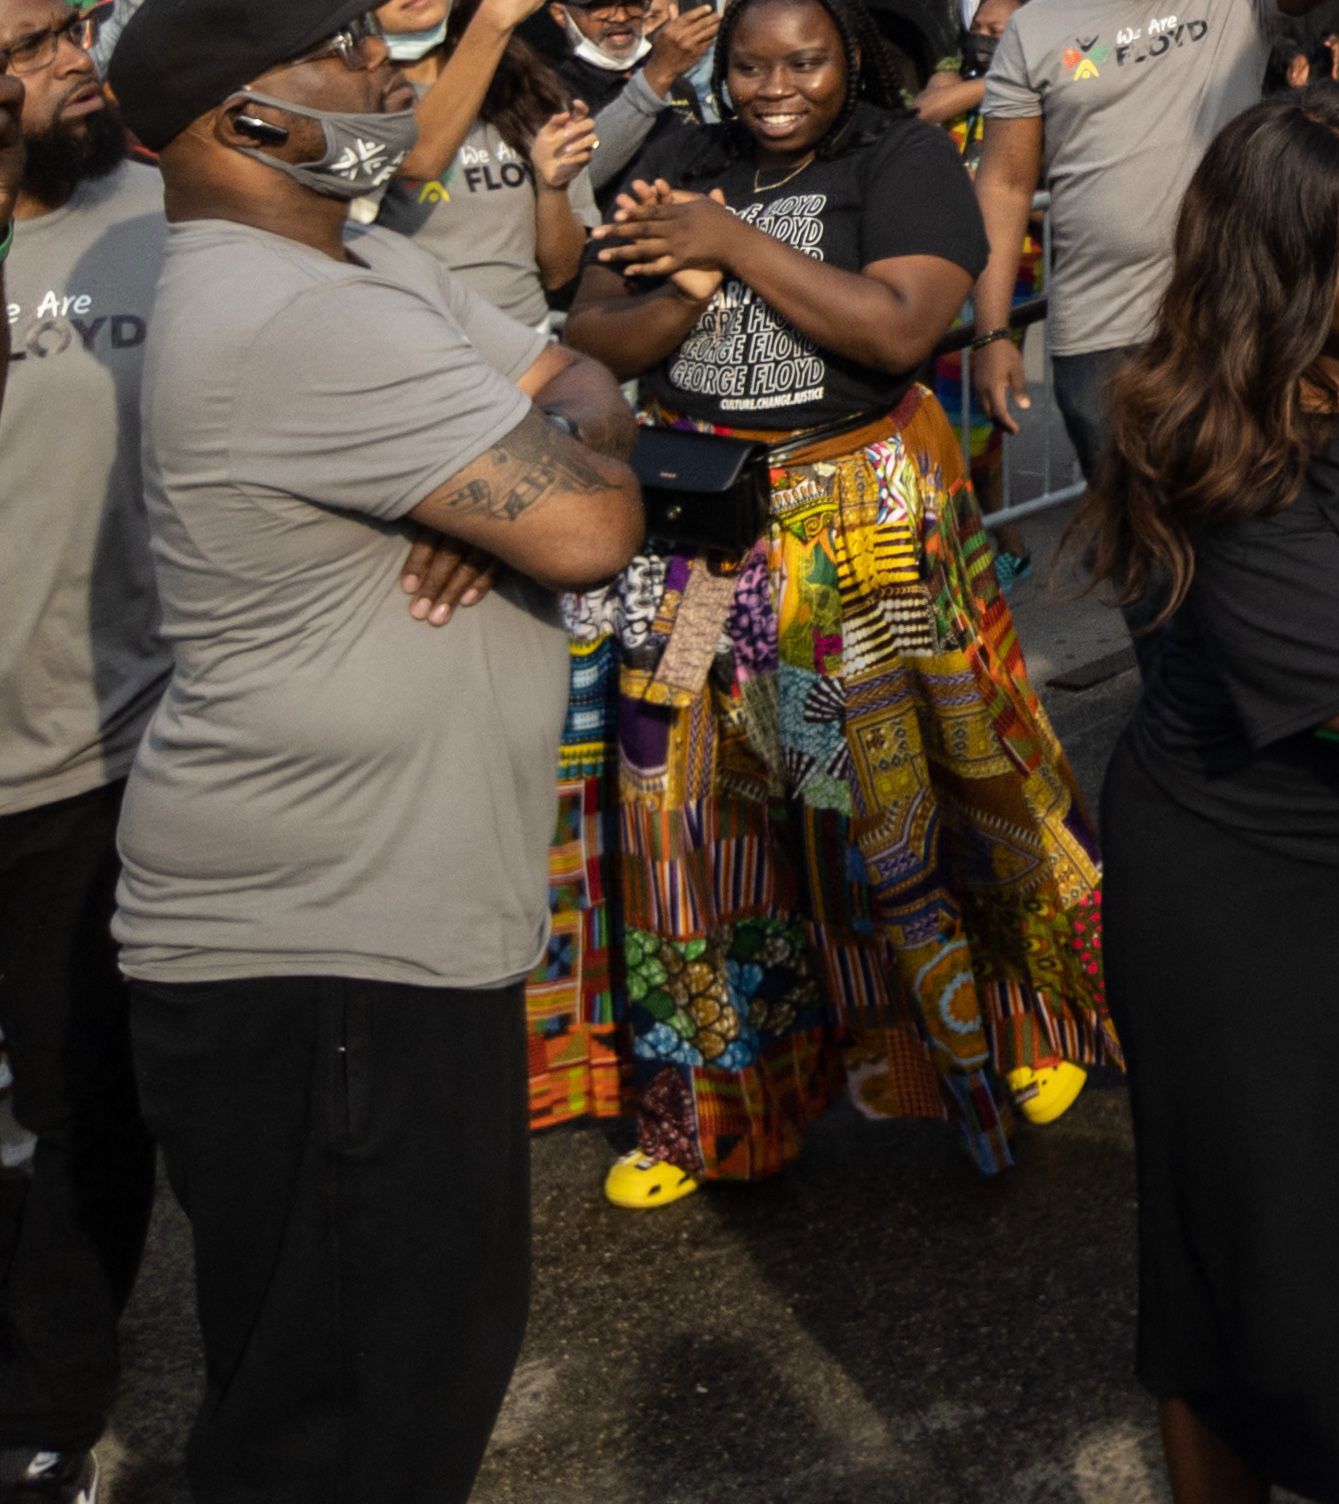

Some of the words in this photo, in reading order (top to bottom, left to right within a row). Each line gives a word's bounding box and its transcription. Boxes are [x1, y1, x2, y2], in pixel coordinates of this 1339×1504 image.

[1148, 15, 1177, 34] Are
[461, 145, 490, 164] We
[37, 290, 92, 318] Are
[669, 359, 748, 396] GEORGE
[750, 357, 826, 395] FLOYD
